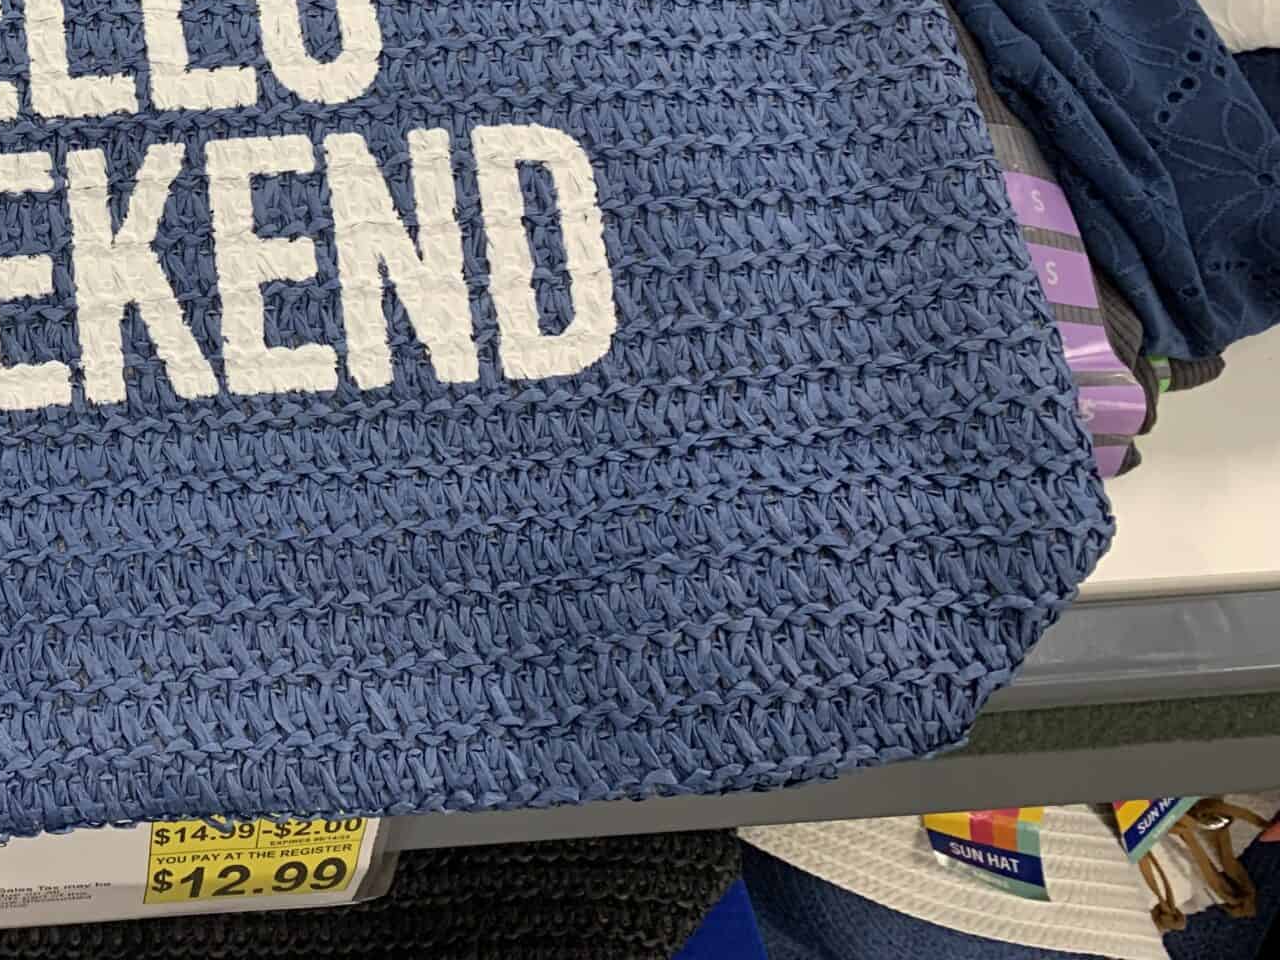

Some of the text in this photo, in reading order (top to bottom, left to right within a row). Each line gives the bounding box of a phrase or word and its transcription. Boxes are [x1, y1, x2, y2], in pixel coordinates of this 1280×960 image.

[1031, 190, 1045, 212] S
[1046, 261, 1059, 285] S
[1137, 806, 1160, 835] SUN
[155, 843, 353, 865] YOU PAY AT THE REGISTER
[950, 842, 1020, 873] SUN HAT
[151, 857, 348, 898] $12.99
